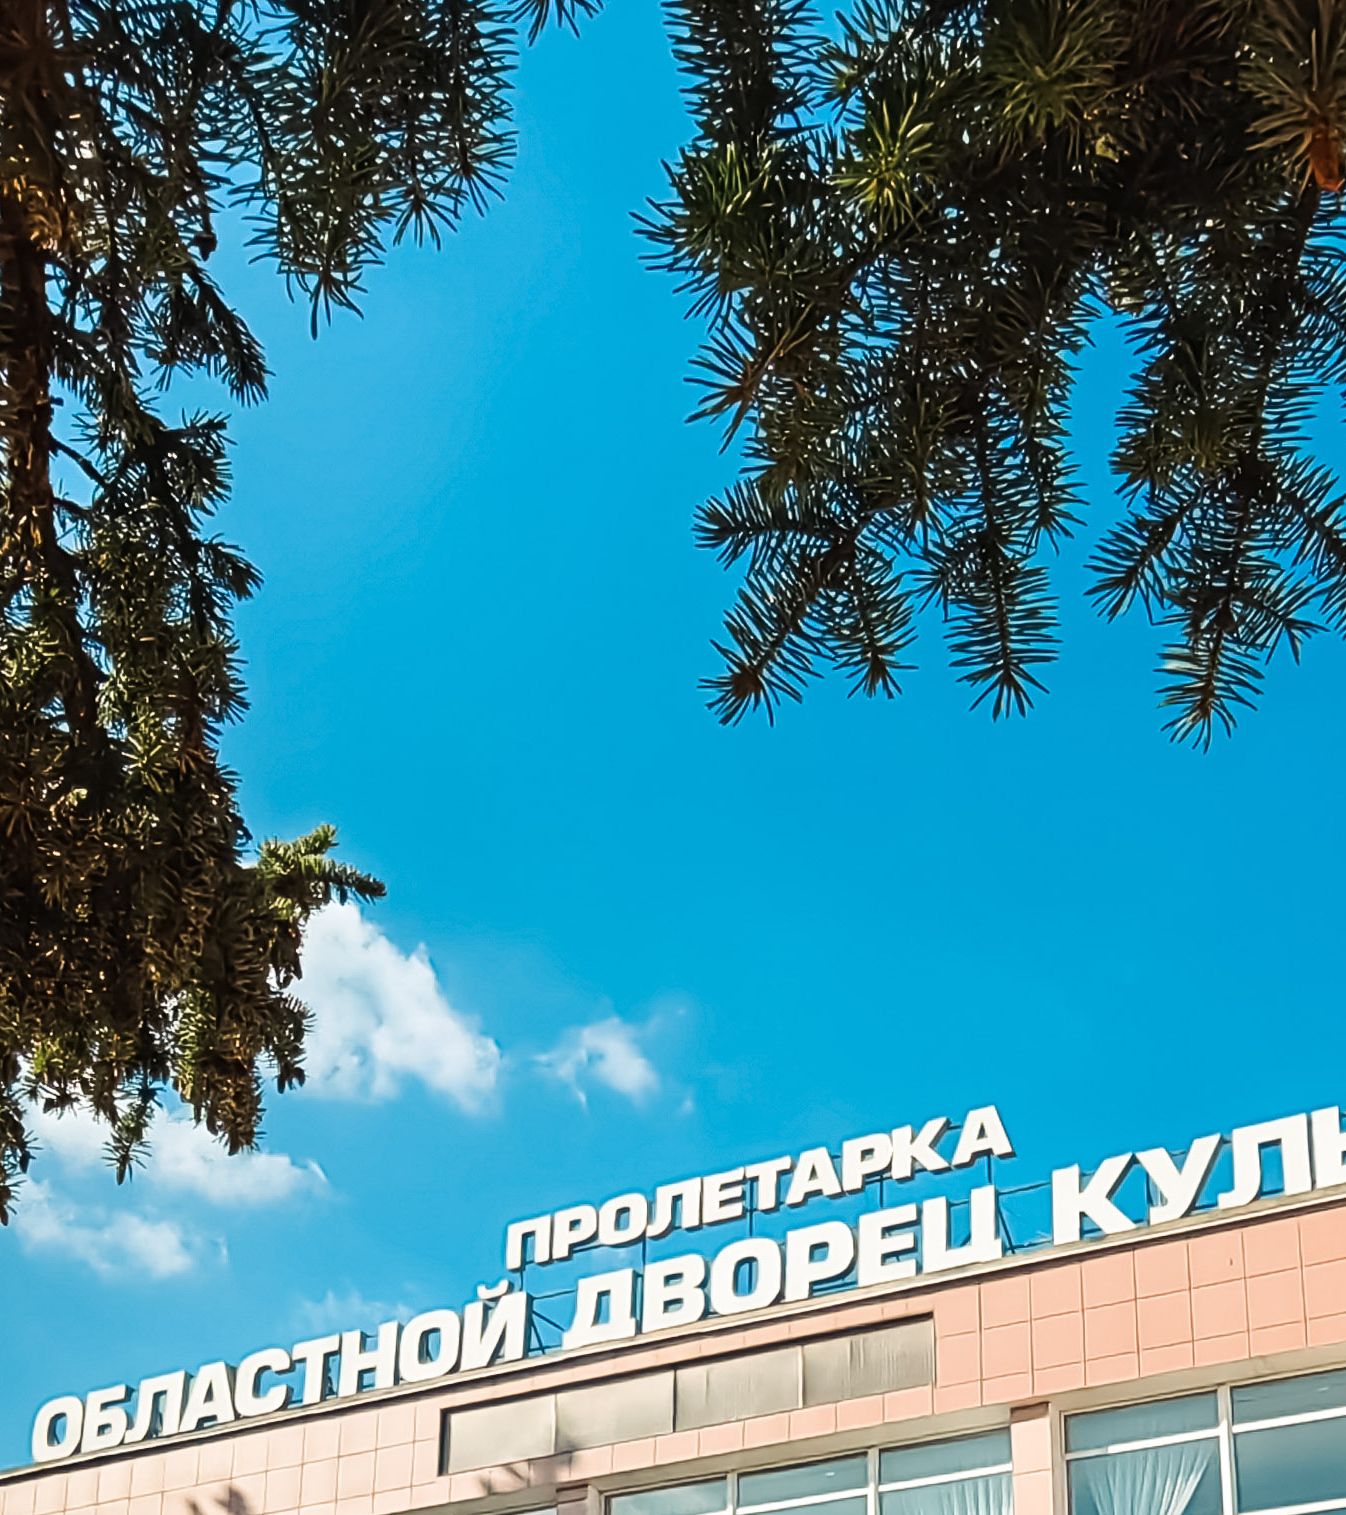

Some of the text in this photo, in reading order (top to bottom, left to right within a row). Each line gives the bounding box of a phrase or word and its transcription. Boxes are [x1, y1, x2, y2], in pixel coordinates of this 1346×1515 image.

[506, 1105, 1014, 1273] ПРОЛЕТАРКА
[32, 1278, 528, 1464] ОБЛАСТНОЙ
[561, 1186, 1004, 1350] ДВОРЕЦ
